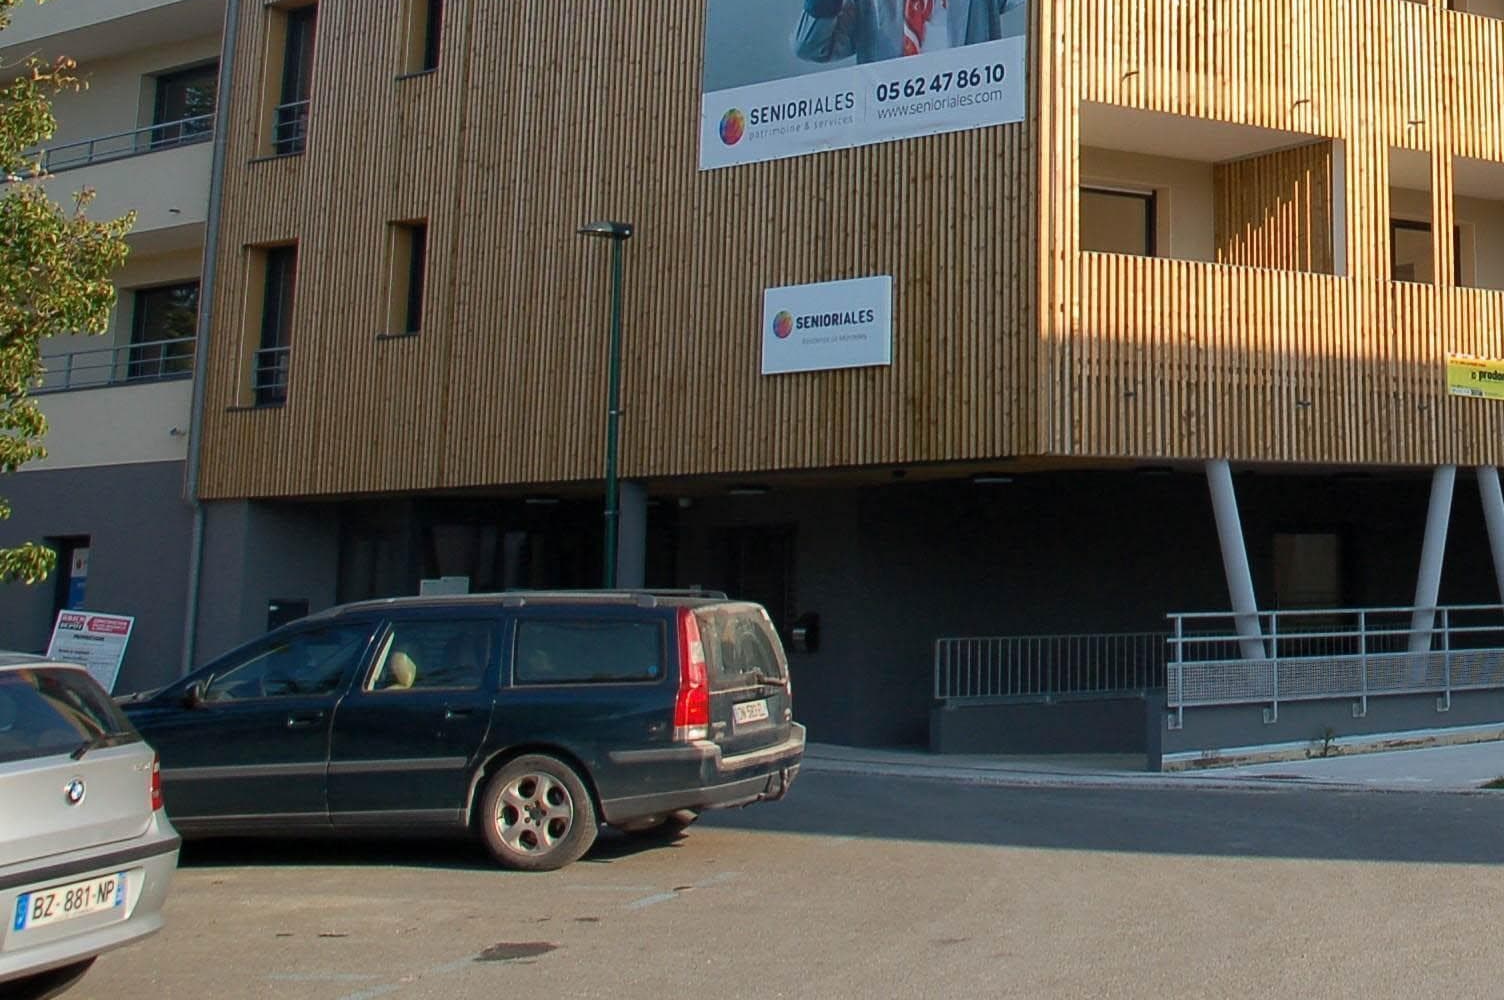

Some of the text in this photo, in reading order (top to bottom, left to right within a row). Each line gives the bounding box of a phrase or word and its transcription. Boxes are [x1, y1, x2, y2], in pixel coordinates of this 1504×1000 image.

[876, 63, 1005, 103] 05 62 47 86 10
[750, 91, 855, 126] SENIORIALES
[877, 88, 1003, 120] www.senioriales.com
[813, 115, 854, 131] services
[796, 309, 874, 330] SENIORIALES
